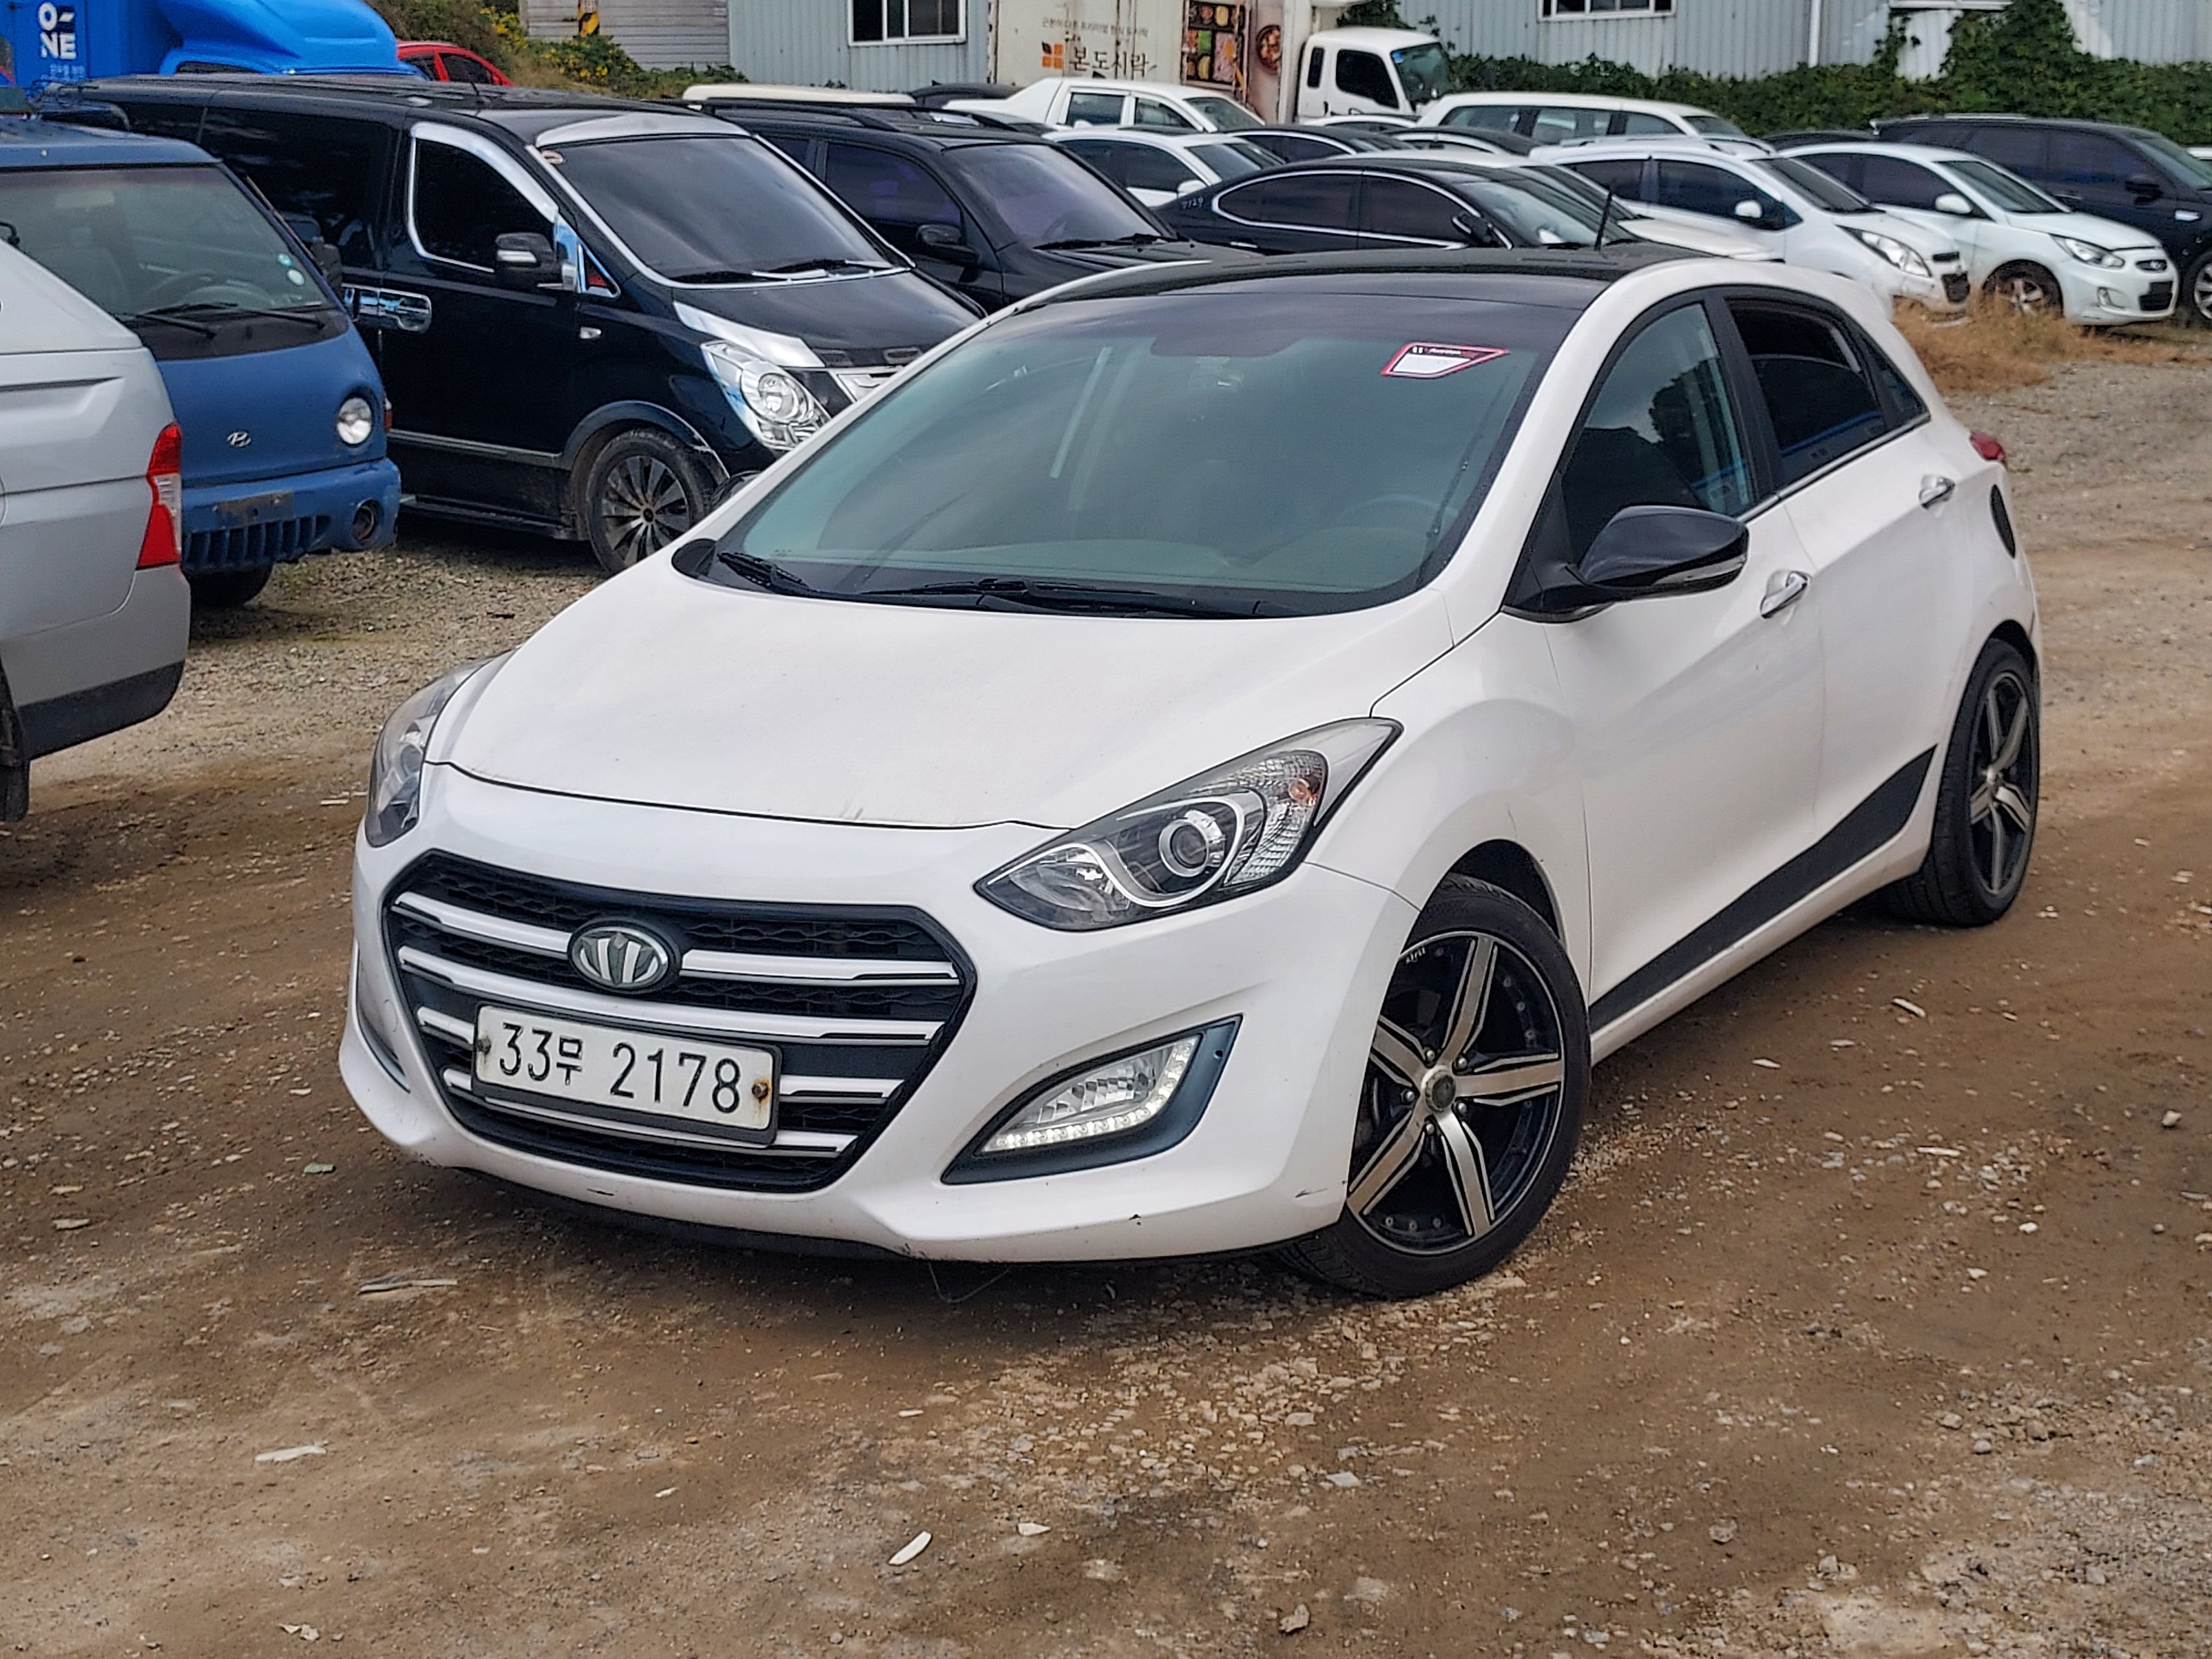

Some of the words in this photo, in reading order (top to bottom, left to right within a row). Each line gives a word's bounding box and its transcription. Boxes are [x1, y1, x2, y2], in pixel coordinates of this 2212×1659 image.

[40, 32, 77, 59] NE
[1068, 46, 1149, 77] 본도시락
[499, 1022, 583, 1086] 33무
[609, 1042, 742, 1114] 2178
